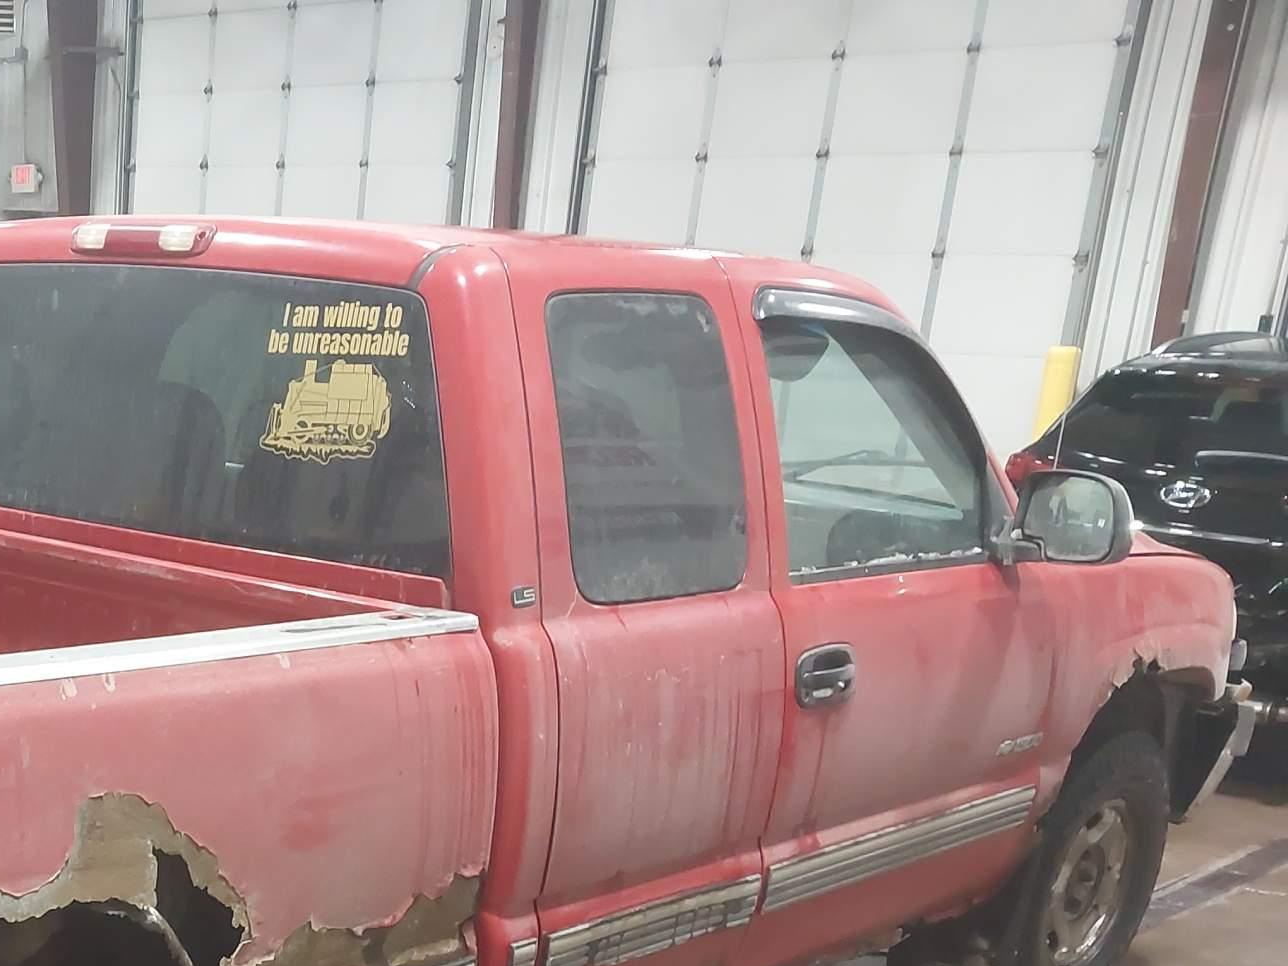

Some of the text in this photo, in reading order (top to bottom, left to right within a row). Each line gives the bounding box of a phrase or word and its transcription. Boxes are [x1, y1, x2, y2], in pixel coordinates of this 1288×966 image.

[282, 301, 403, 331] I am willing to
[268, 329, 410, 357] be unreasonable
[513, 588, 536, 605] LS
